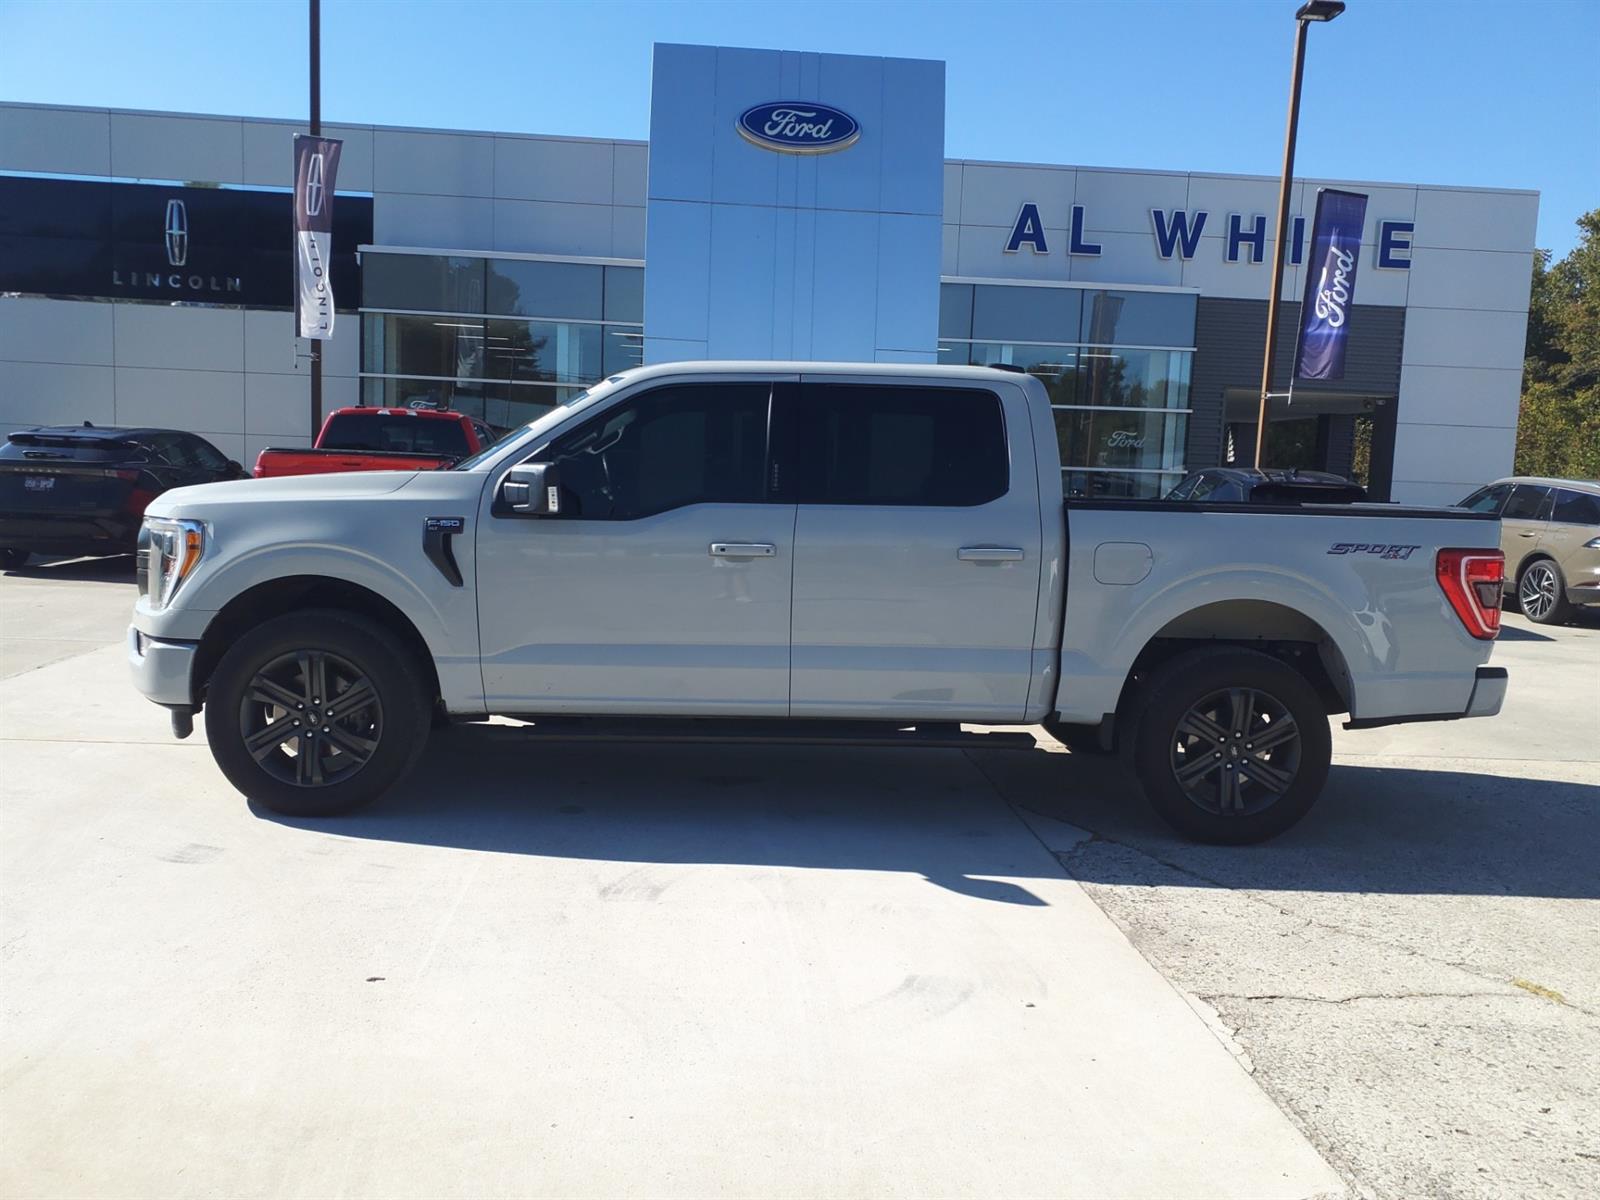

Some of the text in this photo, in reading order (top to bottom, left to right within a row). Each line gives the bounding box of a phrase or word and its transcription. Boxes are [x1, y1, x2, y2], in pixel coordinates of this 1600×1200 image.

[764, 109, 833, 138] Ford
[1003, 202, 1415, 270] AL WHIE
[112, 270, 241, 291] LINCOLN
[1315, 246, 1355, 328] Ford
[1107, 430, 1146, 448] Ford
[1326, 543, 1422, 560] SPORT
